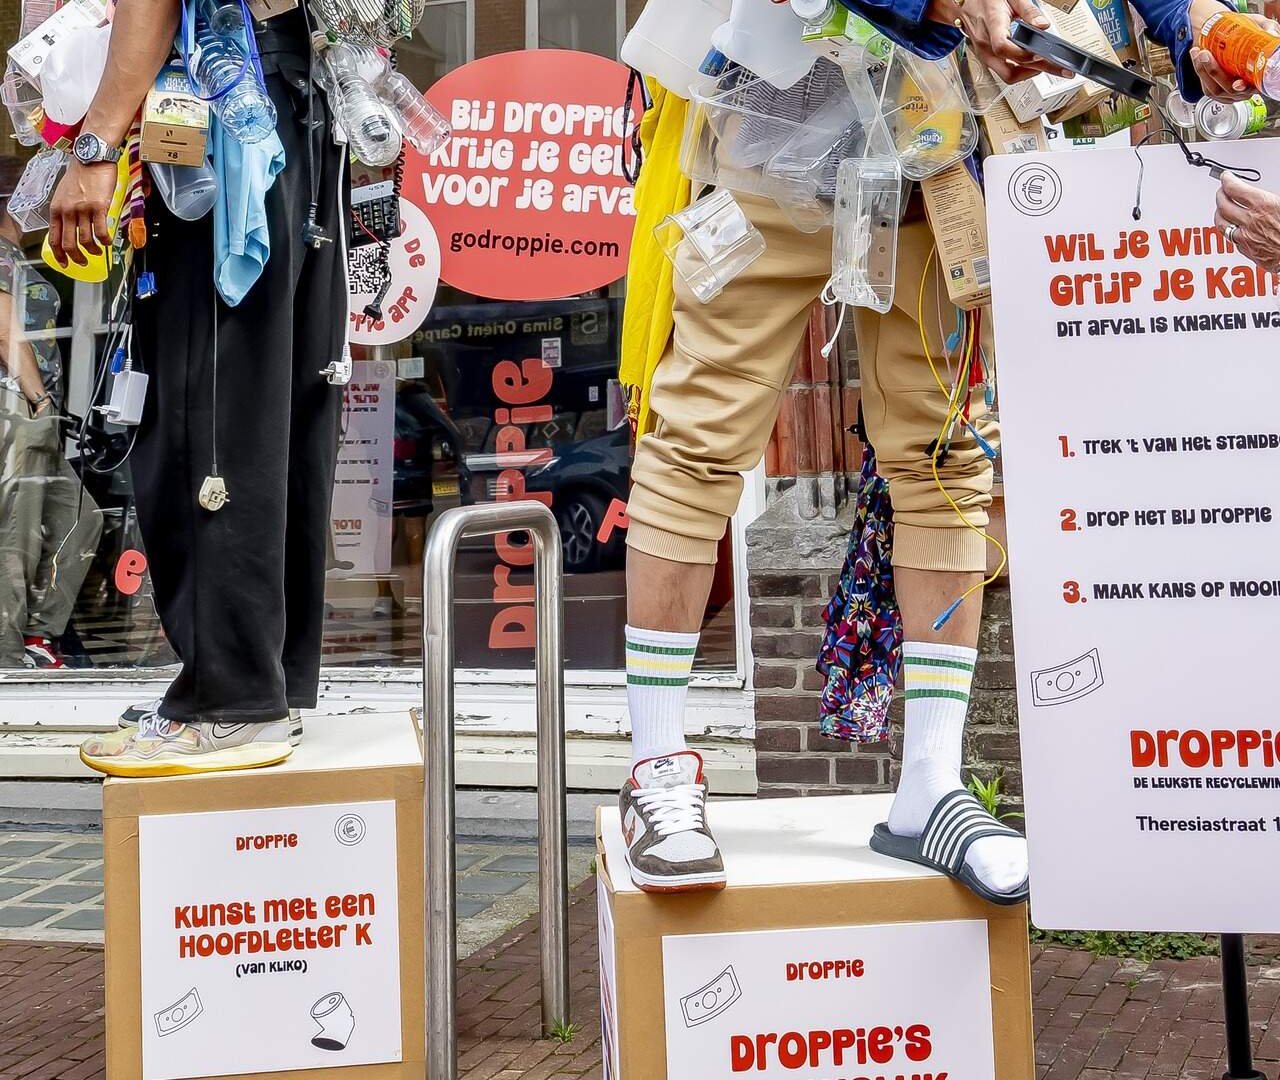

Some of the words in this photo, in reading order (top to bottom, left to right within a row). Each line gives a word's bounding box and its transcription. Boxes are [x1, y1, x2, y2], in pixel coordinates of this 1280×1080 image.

[1108, 30, 1122, 46] ELK
[561, 183, 638, 216] afva
[450, 229, 620, 258] godroppie.com
[1160, 225, 1235, 257] win
[1206, 265, 1280, 299] kan
[1059, 435, 1076, 457] 1.
[1060, 508, 1082, 531] 2.
[1062, 580, 1087, 604] 3.
[1093, 583, 1145, 600] MAAK
[1148, 582, 1197, 599] KANS
[1201, 581, 1226, 598] OP
[1133, 776, 1149, 789] DE
[1151, 776, 1203, 789] LEUKSTE
[1136, 815, 1267, 833] Theresiastraat
[355, 921, 373, 946] K
